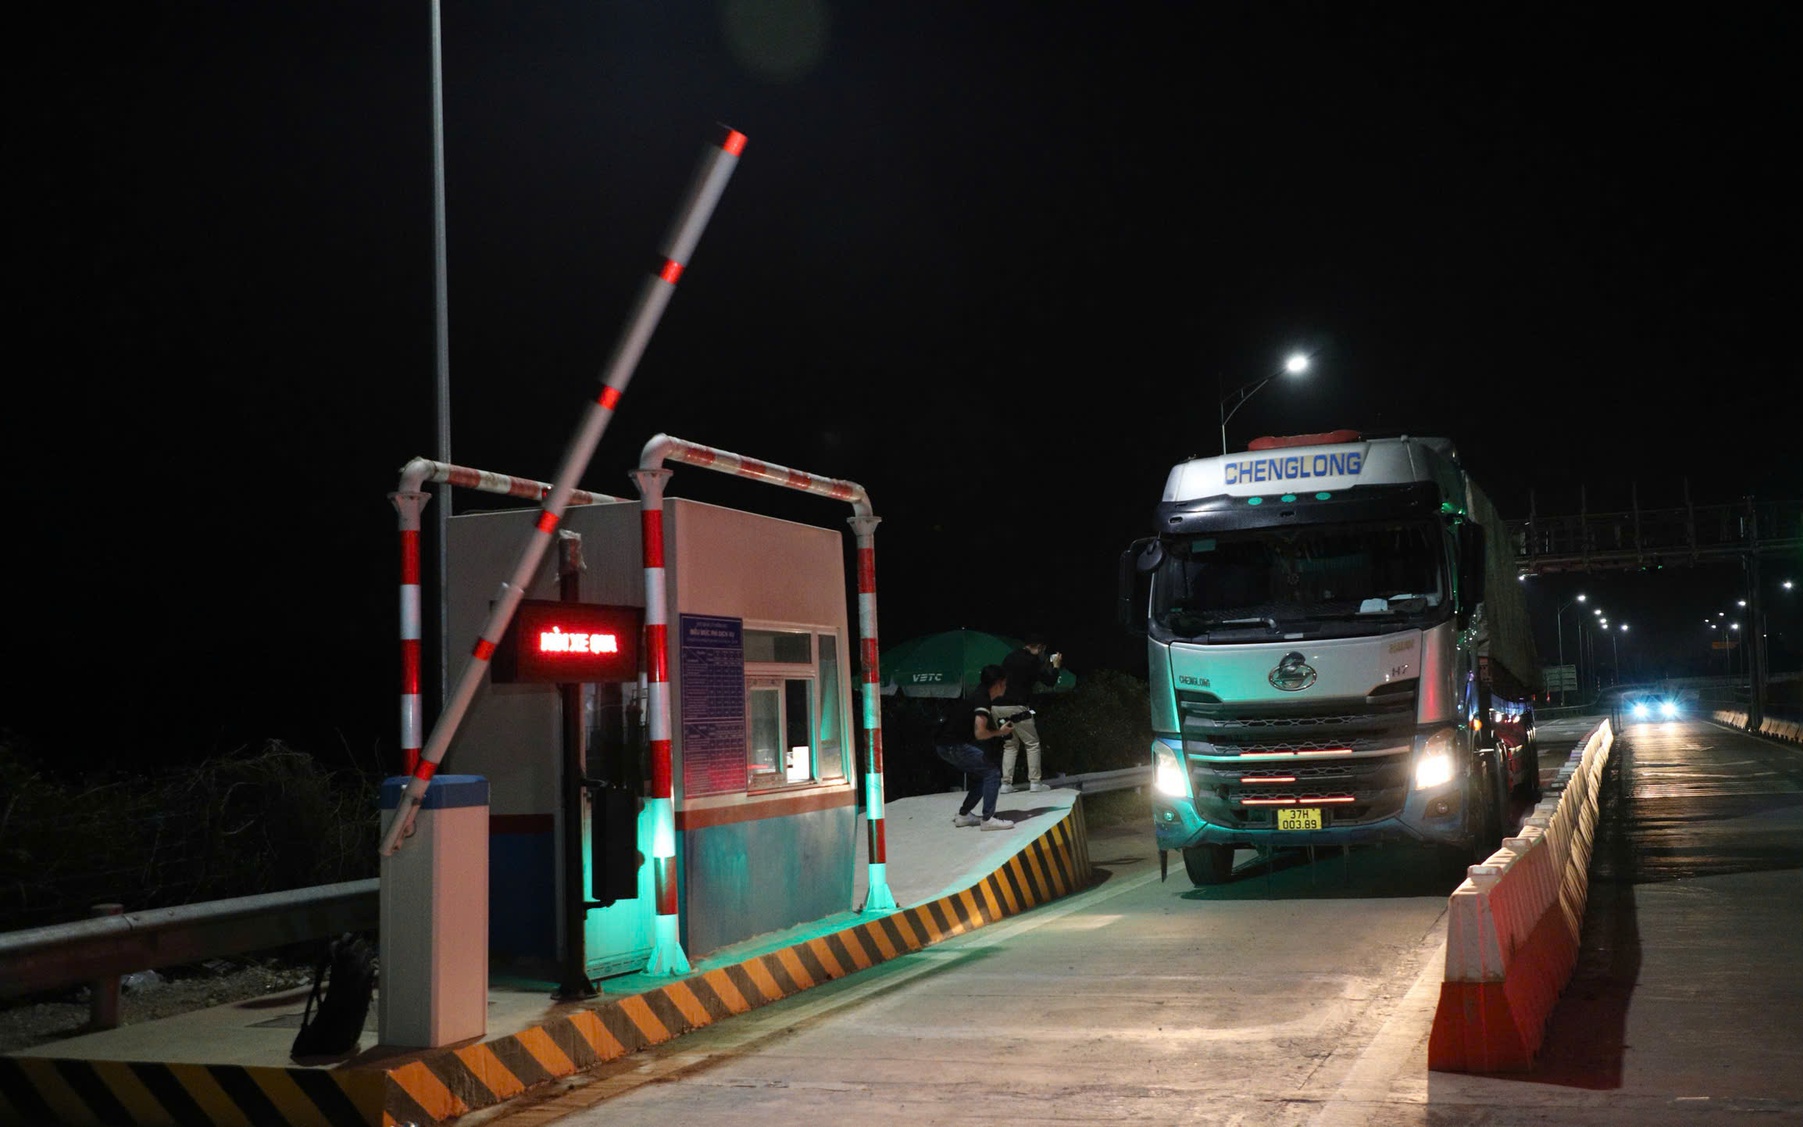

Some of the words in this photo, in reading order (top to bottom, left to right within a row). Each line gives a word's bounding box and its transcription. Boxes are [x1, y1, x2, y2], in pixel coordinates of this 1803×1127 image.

[1225, 452, 1361, 485] CHENGLONG
[569, 633, 589, 652] XE
[1392, 664, 1409, 677] H7
[912, 673, 943, 683] VETC
[1290, 810, 1309, 819] 37H
[1282, 819, 1317, 830] 003.89
